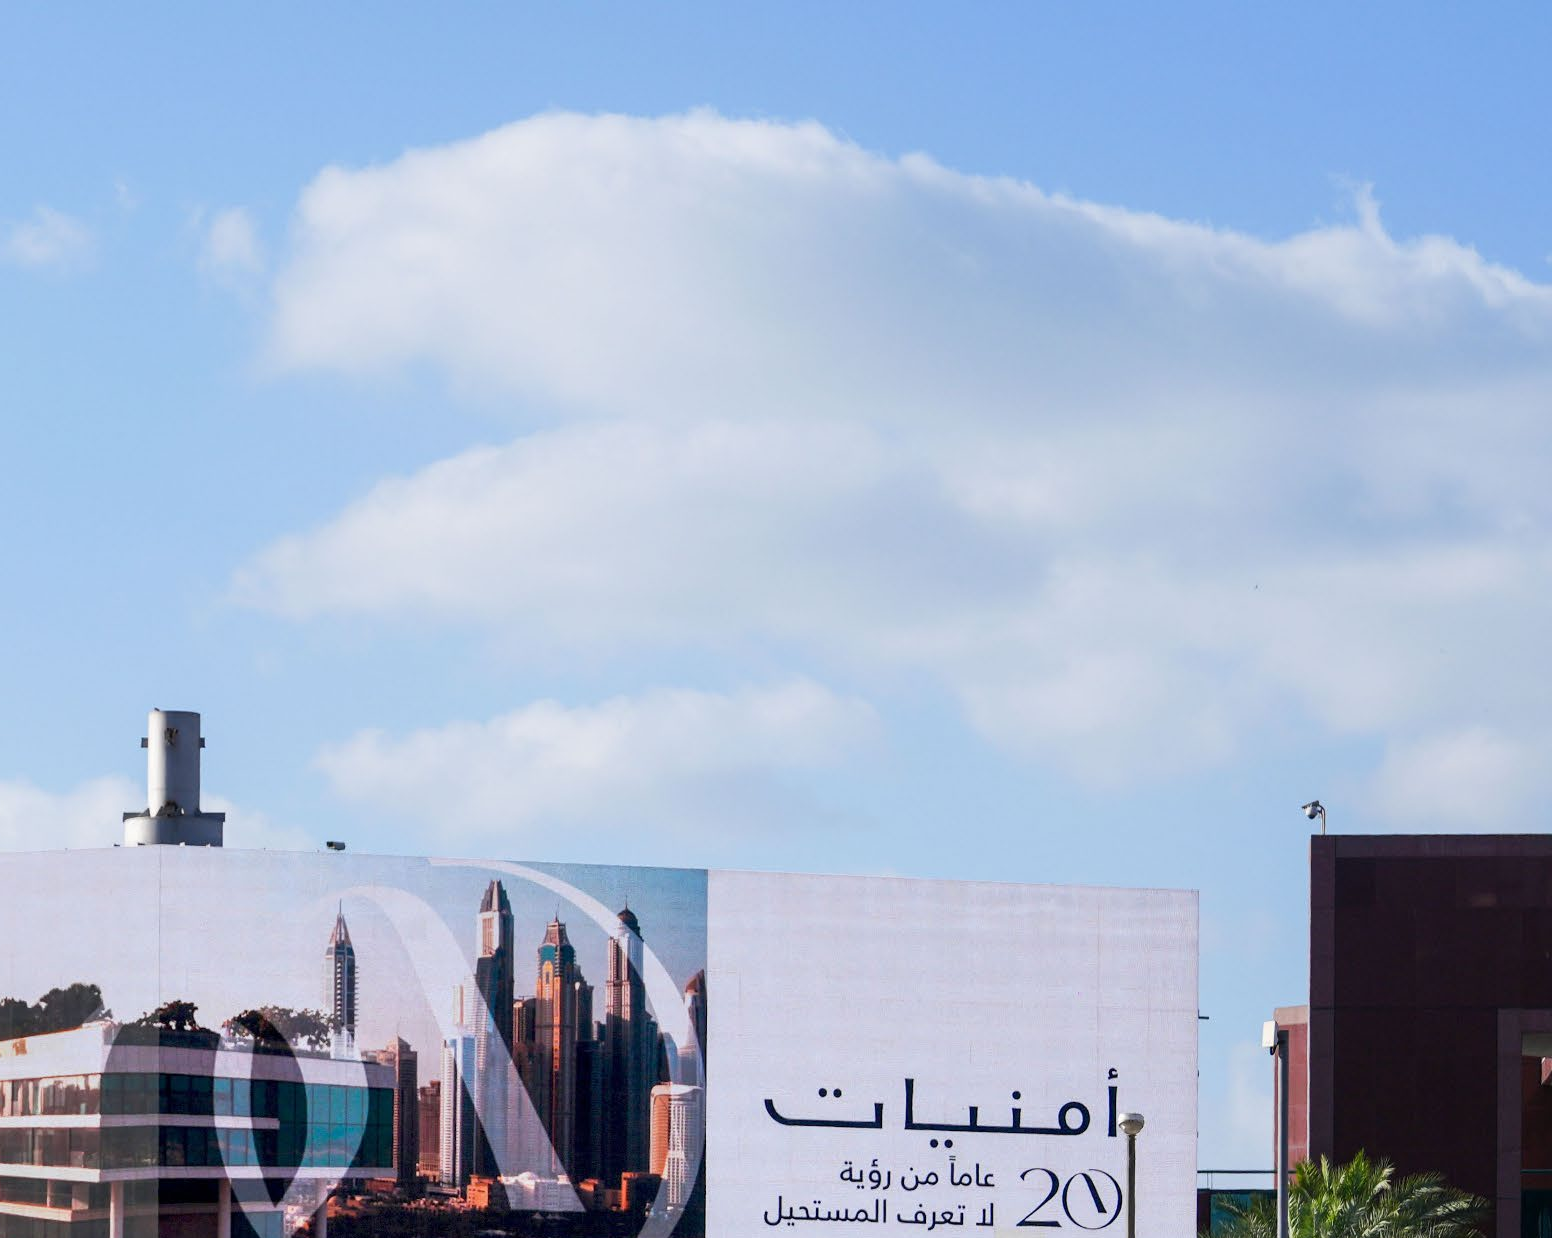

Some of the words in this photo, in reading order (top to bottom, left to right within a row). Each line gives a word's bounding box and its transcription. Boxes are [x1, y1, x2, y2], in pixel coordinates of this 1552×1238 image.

[763, 1067, 1119, 1149] أمنيات
[839, 1158, 892, 1191] رؤية
[900, 1166, 939, 1191] من
[763, 1195, 887, 1227] المستحيل
[975, 1202, 995, 1228] لا
[1015, 1167, 1123, 1231] 20
[896, 1203, 966, 1232] تعرف
